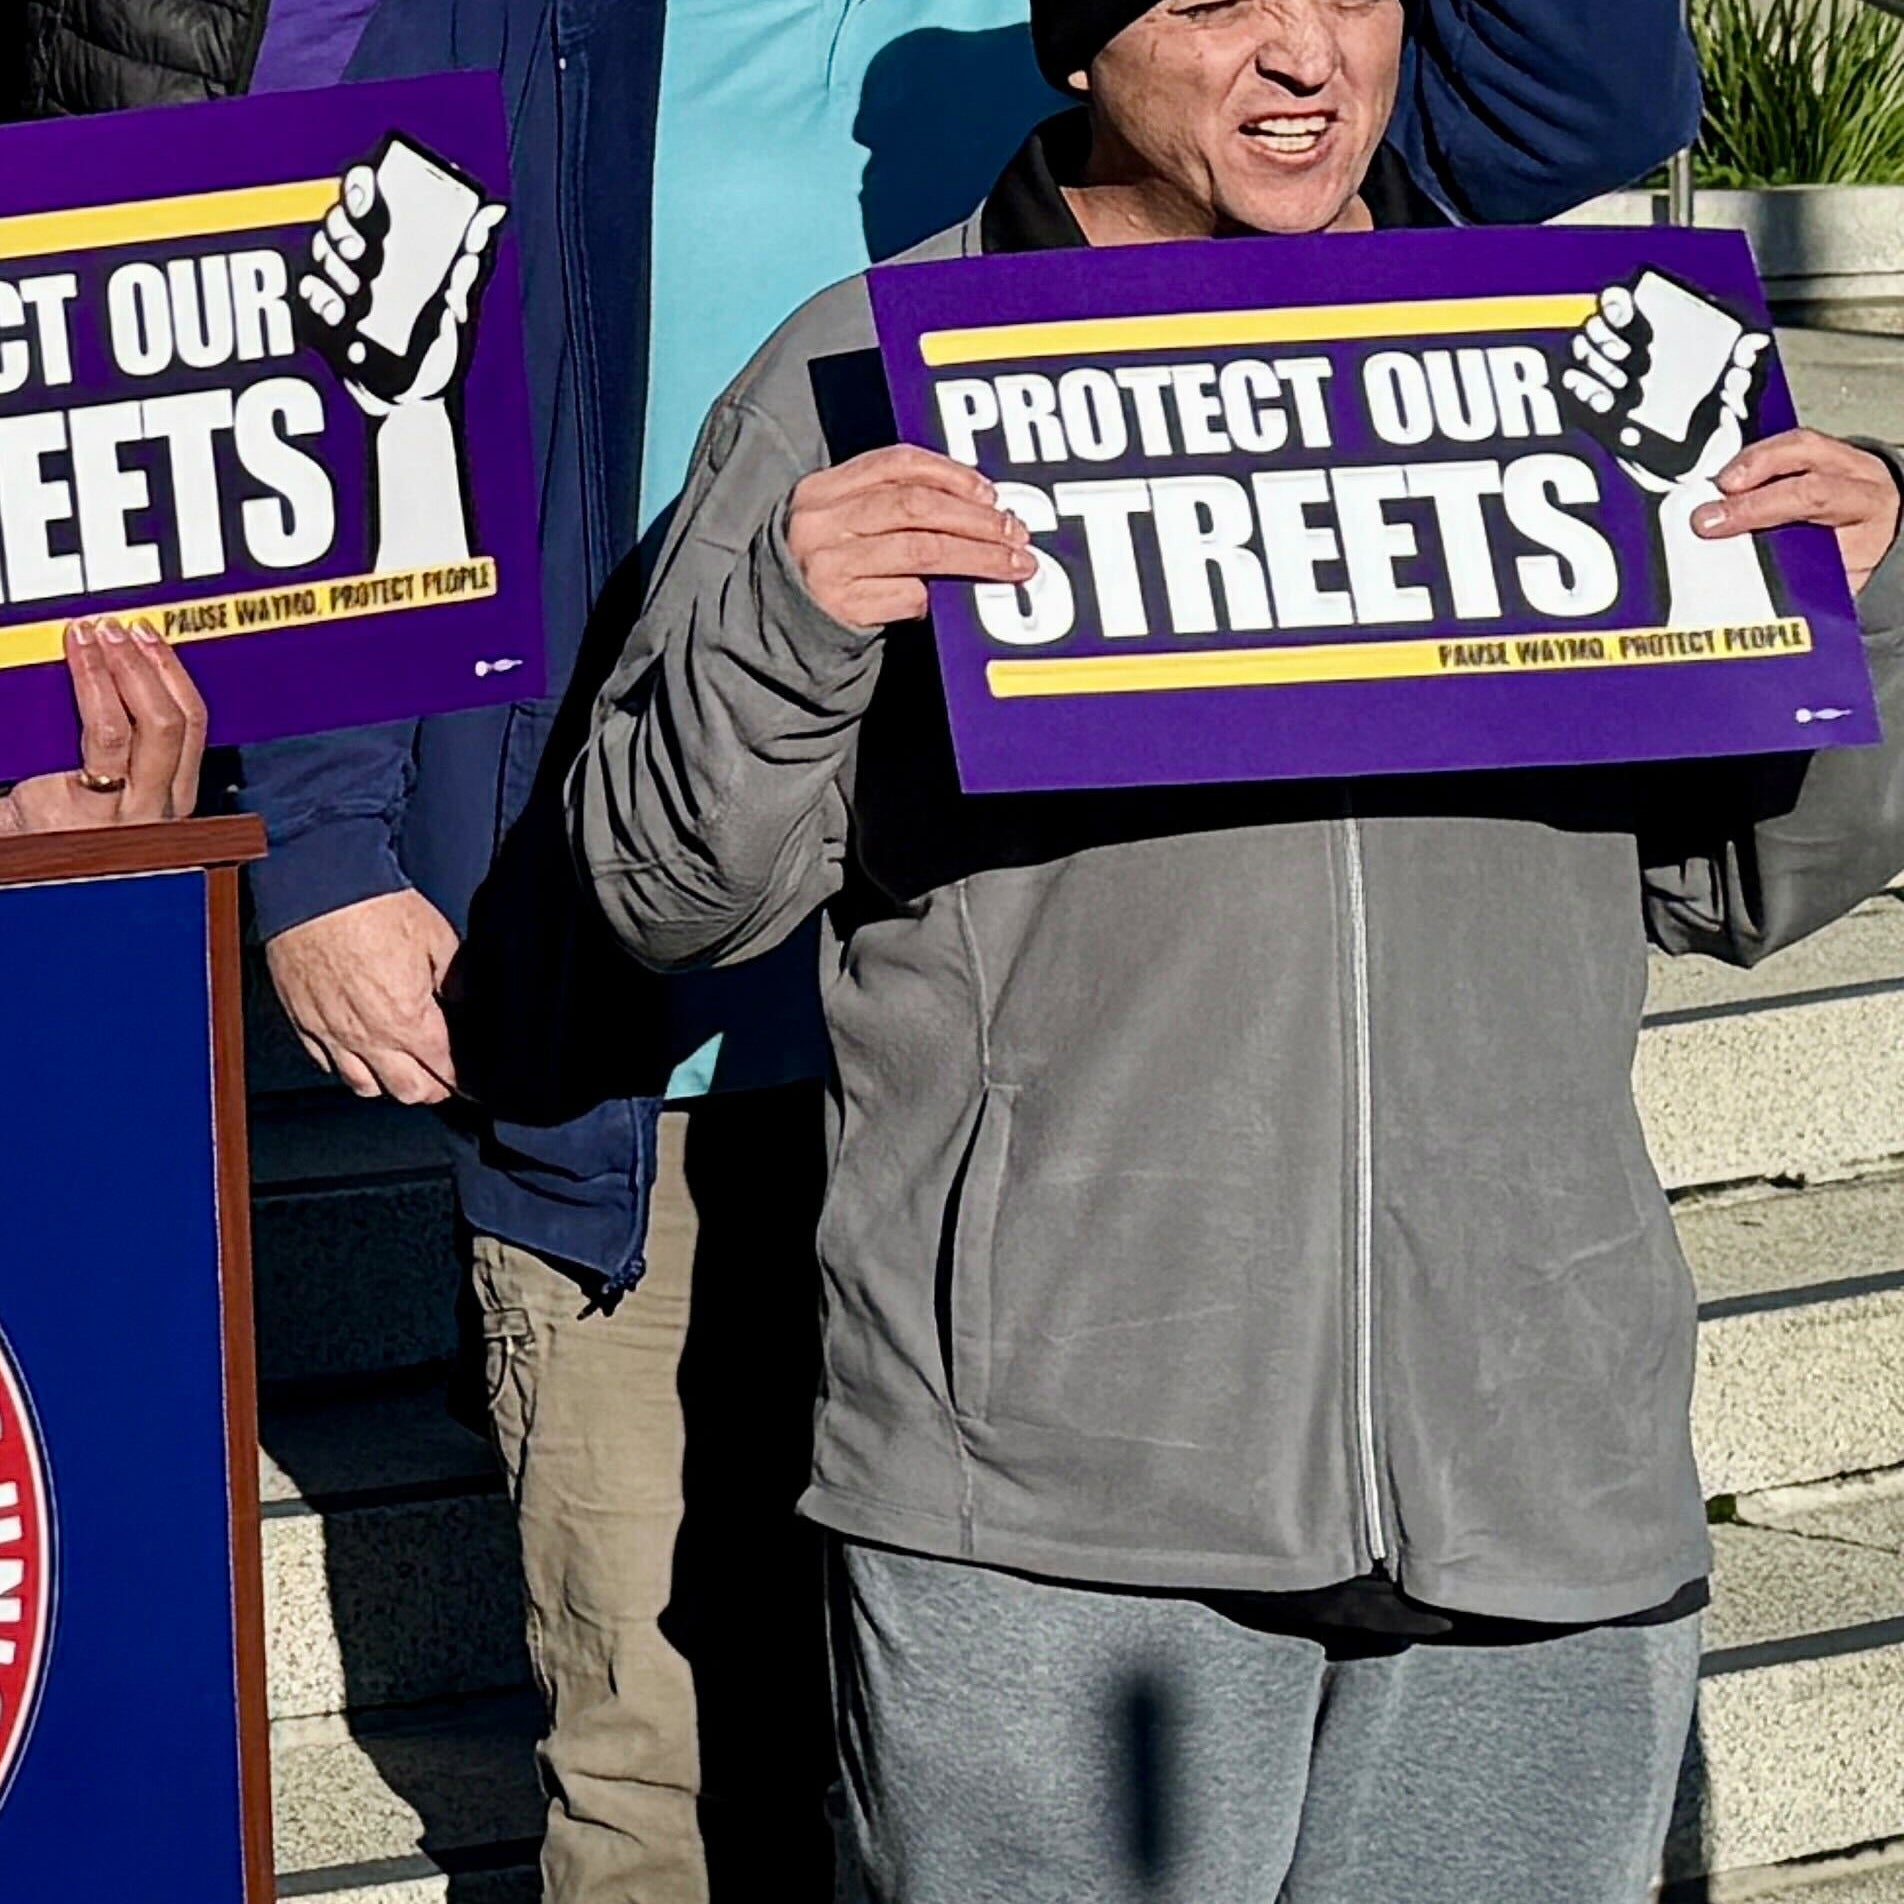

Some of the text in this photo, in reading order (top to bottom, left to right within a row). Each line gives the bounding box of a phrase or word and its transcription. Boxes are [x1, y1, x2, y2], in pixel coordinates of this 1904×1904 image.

[107, 247, 297, 377] OUR
[935, 345, 1561, 467] PROTECT OUR
[163, 602, 227, 637] PAUSE
[328, 574, 416, 613] PROTECT
[421, 562, 490, 598] PEOPLE
[973, 453, 1620, 647] STREETS
[1439, 642, 1510, 669] PAUSE
[1618, 629, 1718, 660] PROTECT
[1723, 622, 1803, 652] PEOPLE
